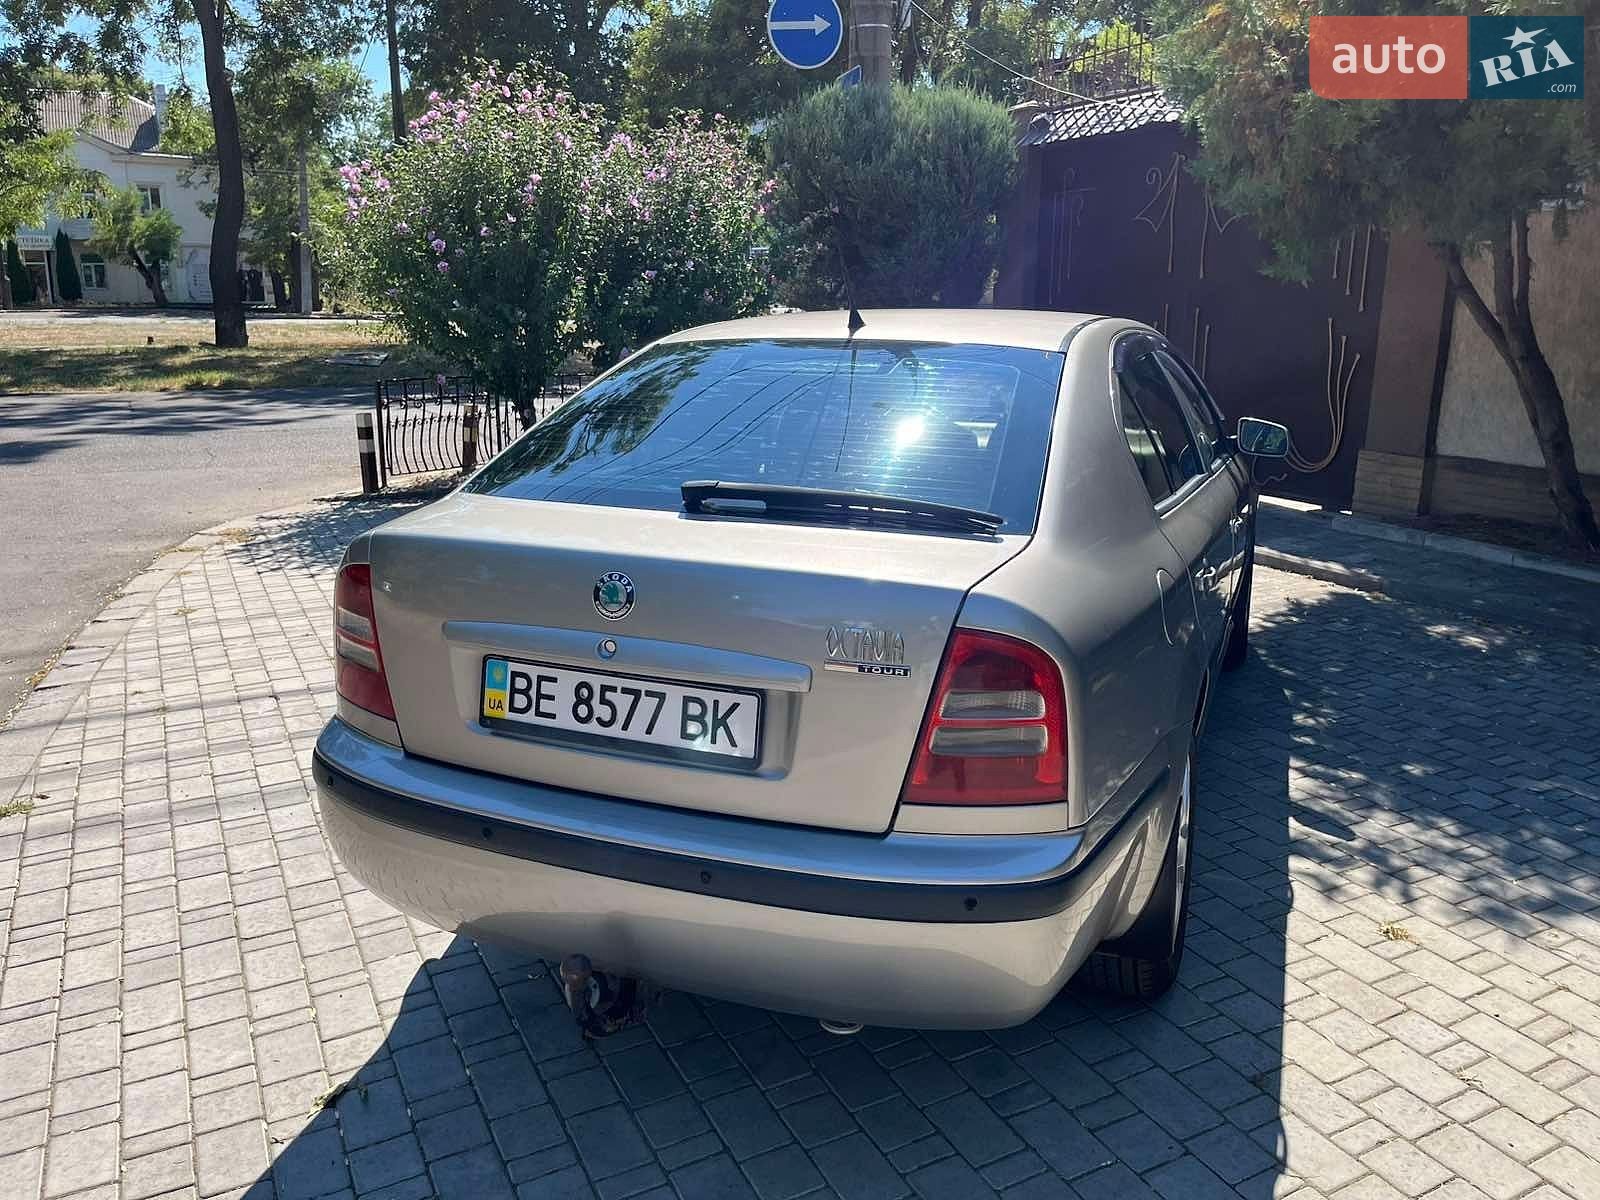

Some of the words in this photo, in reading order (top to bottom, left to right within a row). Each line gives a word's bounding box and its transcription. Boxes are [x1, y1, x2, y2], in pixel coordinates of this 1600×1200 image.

[825, 625, 905, 664] OCTAVIA
[862, 665, 905, 676] TOUR
[488, 697, 504, 712] UA
[508, 670, 559, 720] BE
[571, 681, 667, 736] 8577
[680, 695, 742, 748] BK
